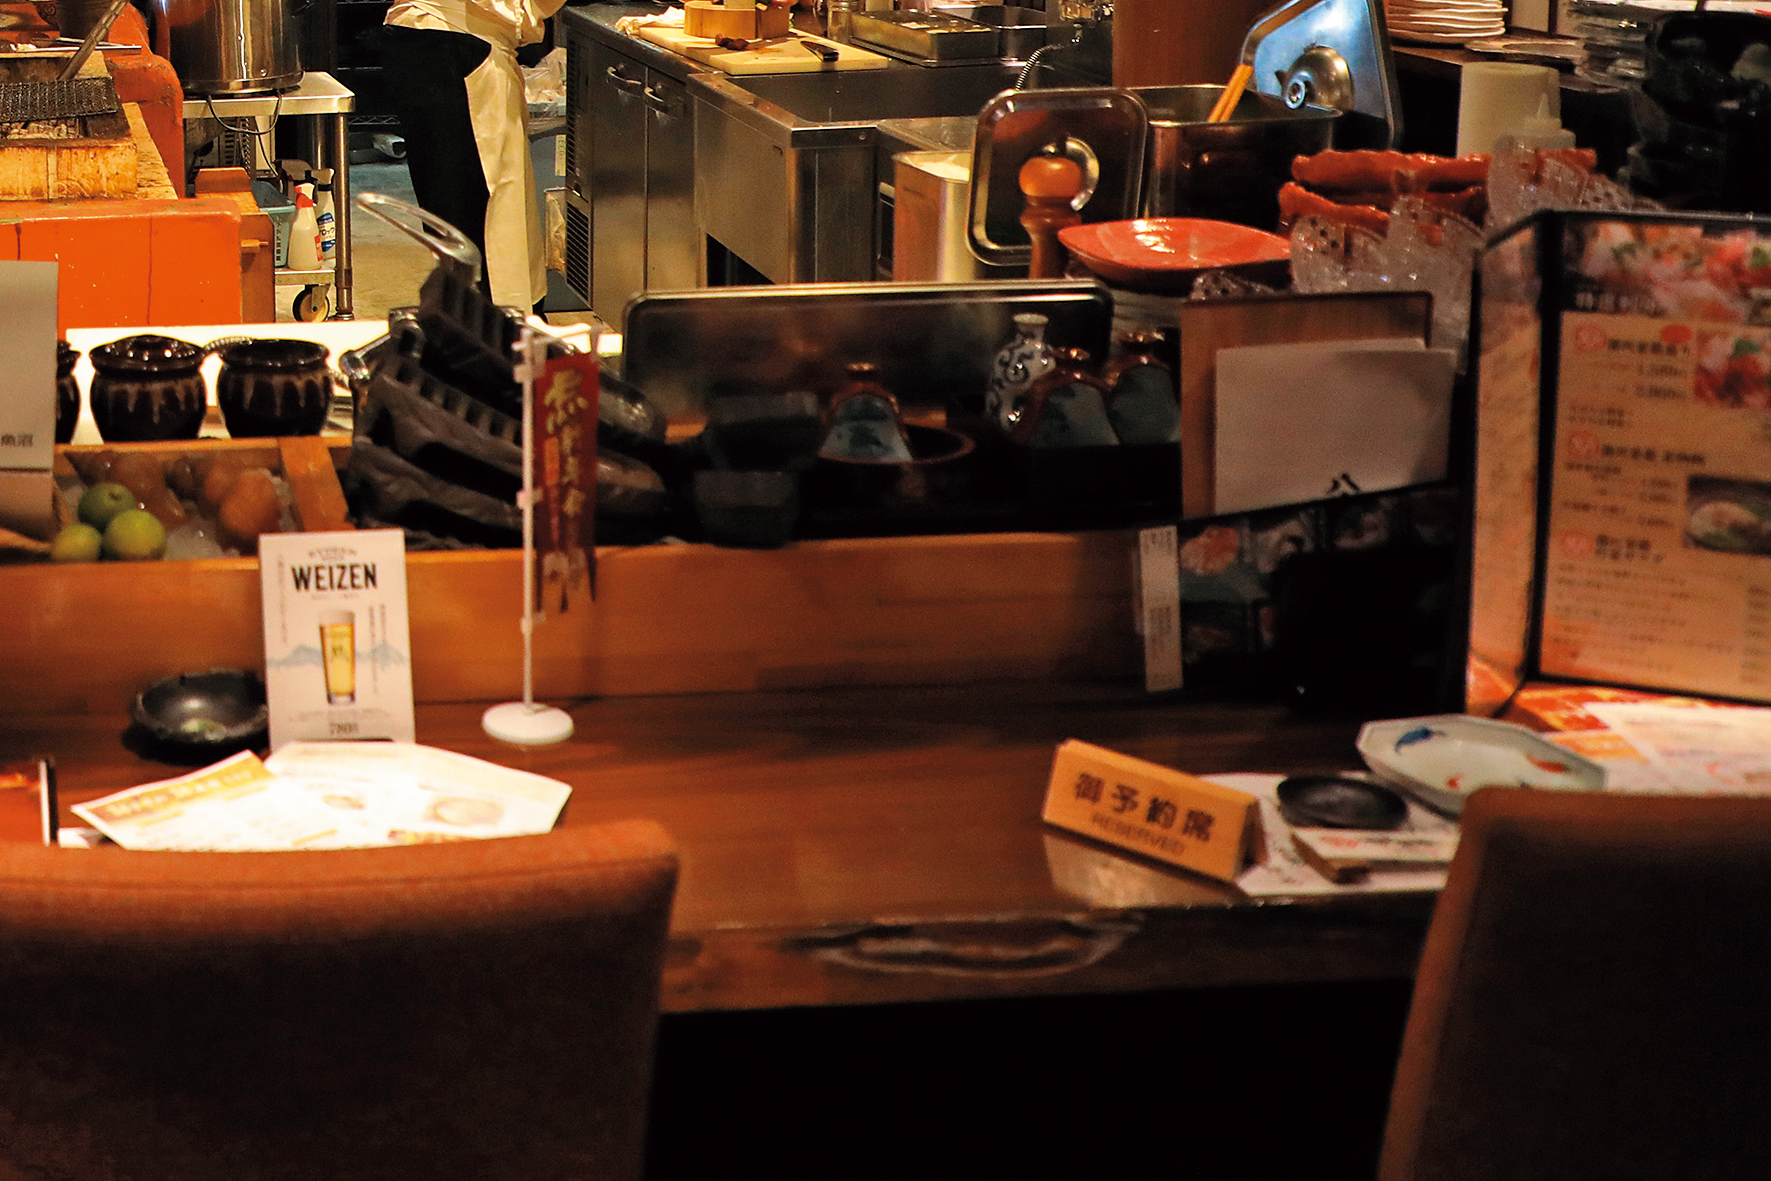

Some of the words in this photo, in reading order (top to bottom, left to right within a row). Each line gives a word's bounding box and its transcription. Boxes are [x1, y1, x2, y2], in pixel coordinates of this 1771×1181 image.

[291, 562, 378, 593] WEIZEN
[1075, 772, 1217, 843] 御予約席
